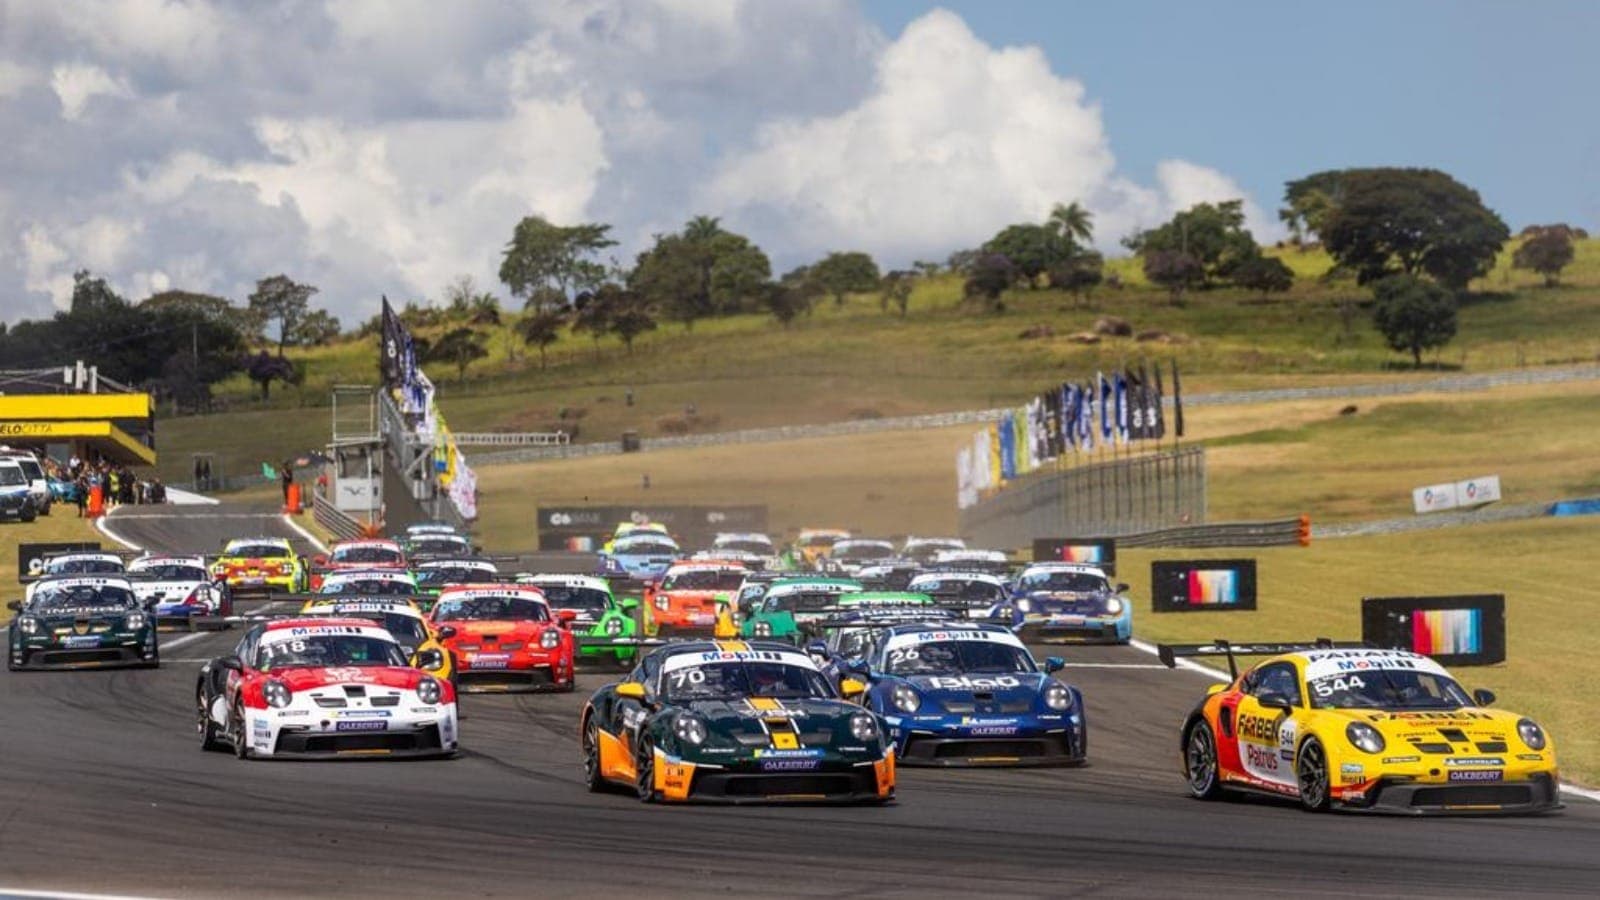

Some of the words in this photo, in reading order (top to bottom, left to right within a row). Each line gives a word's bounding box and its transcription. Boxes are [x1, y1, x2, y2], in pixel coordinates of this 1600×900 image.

[291, 627, 343, 636] Mobil
[919, 631, 970, 641] Mobil
[262, 640, 306, 659] 118
[889, 648, 920, 664] 26
[701, 651, 761, 662] Mobil
[1337, 660, 1394, 670] Mobil
[670, 670, 706, 689] 70
[1314, 675, 1366, 697] 544
[1237, 713, 1280, 742] FARBEN
[1247, 744, 1278, 770] Patrus
[763, 760, 818, 770] OAKBERRY
[1450, 770, 1500, 780] OAKBERRY
